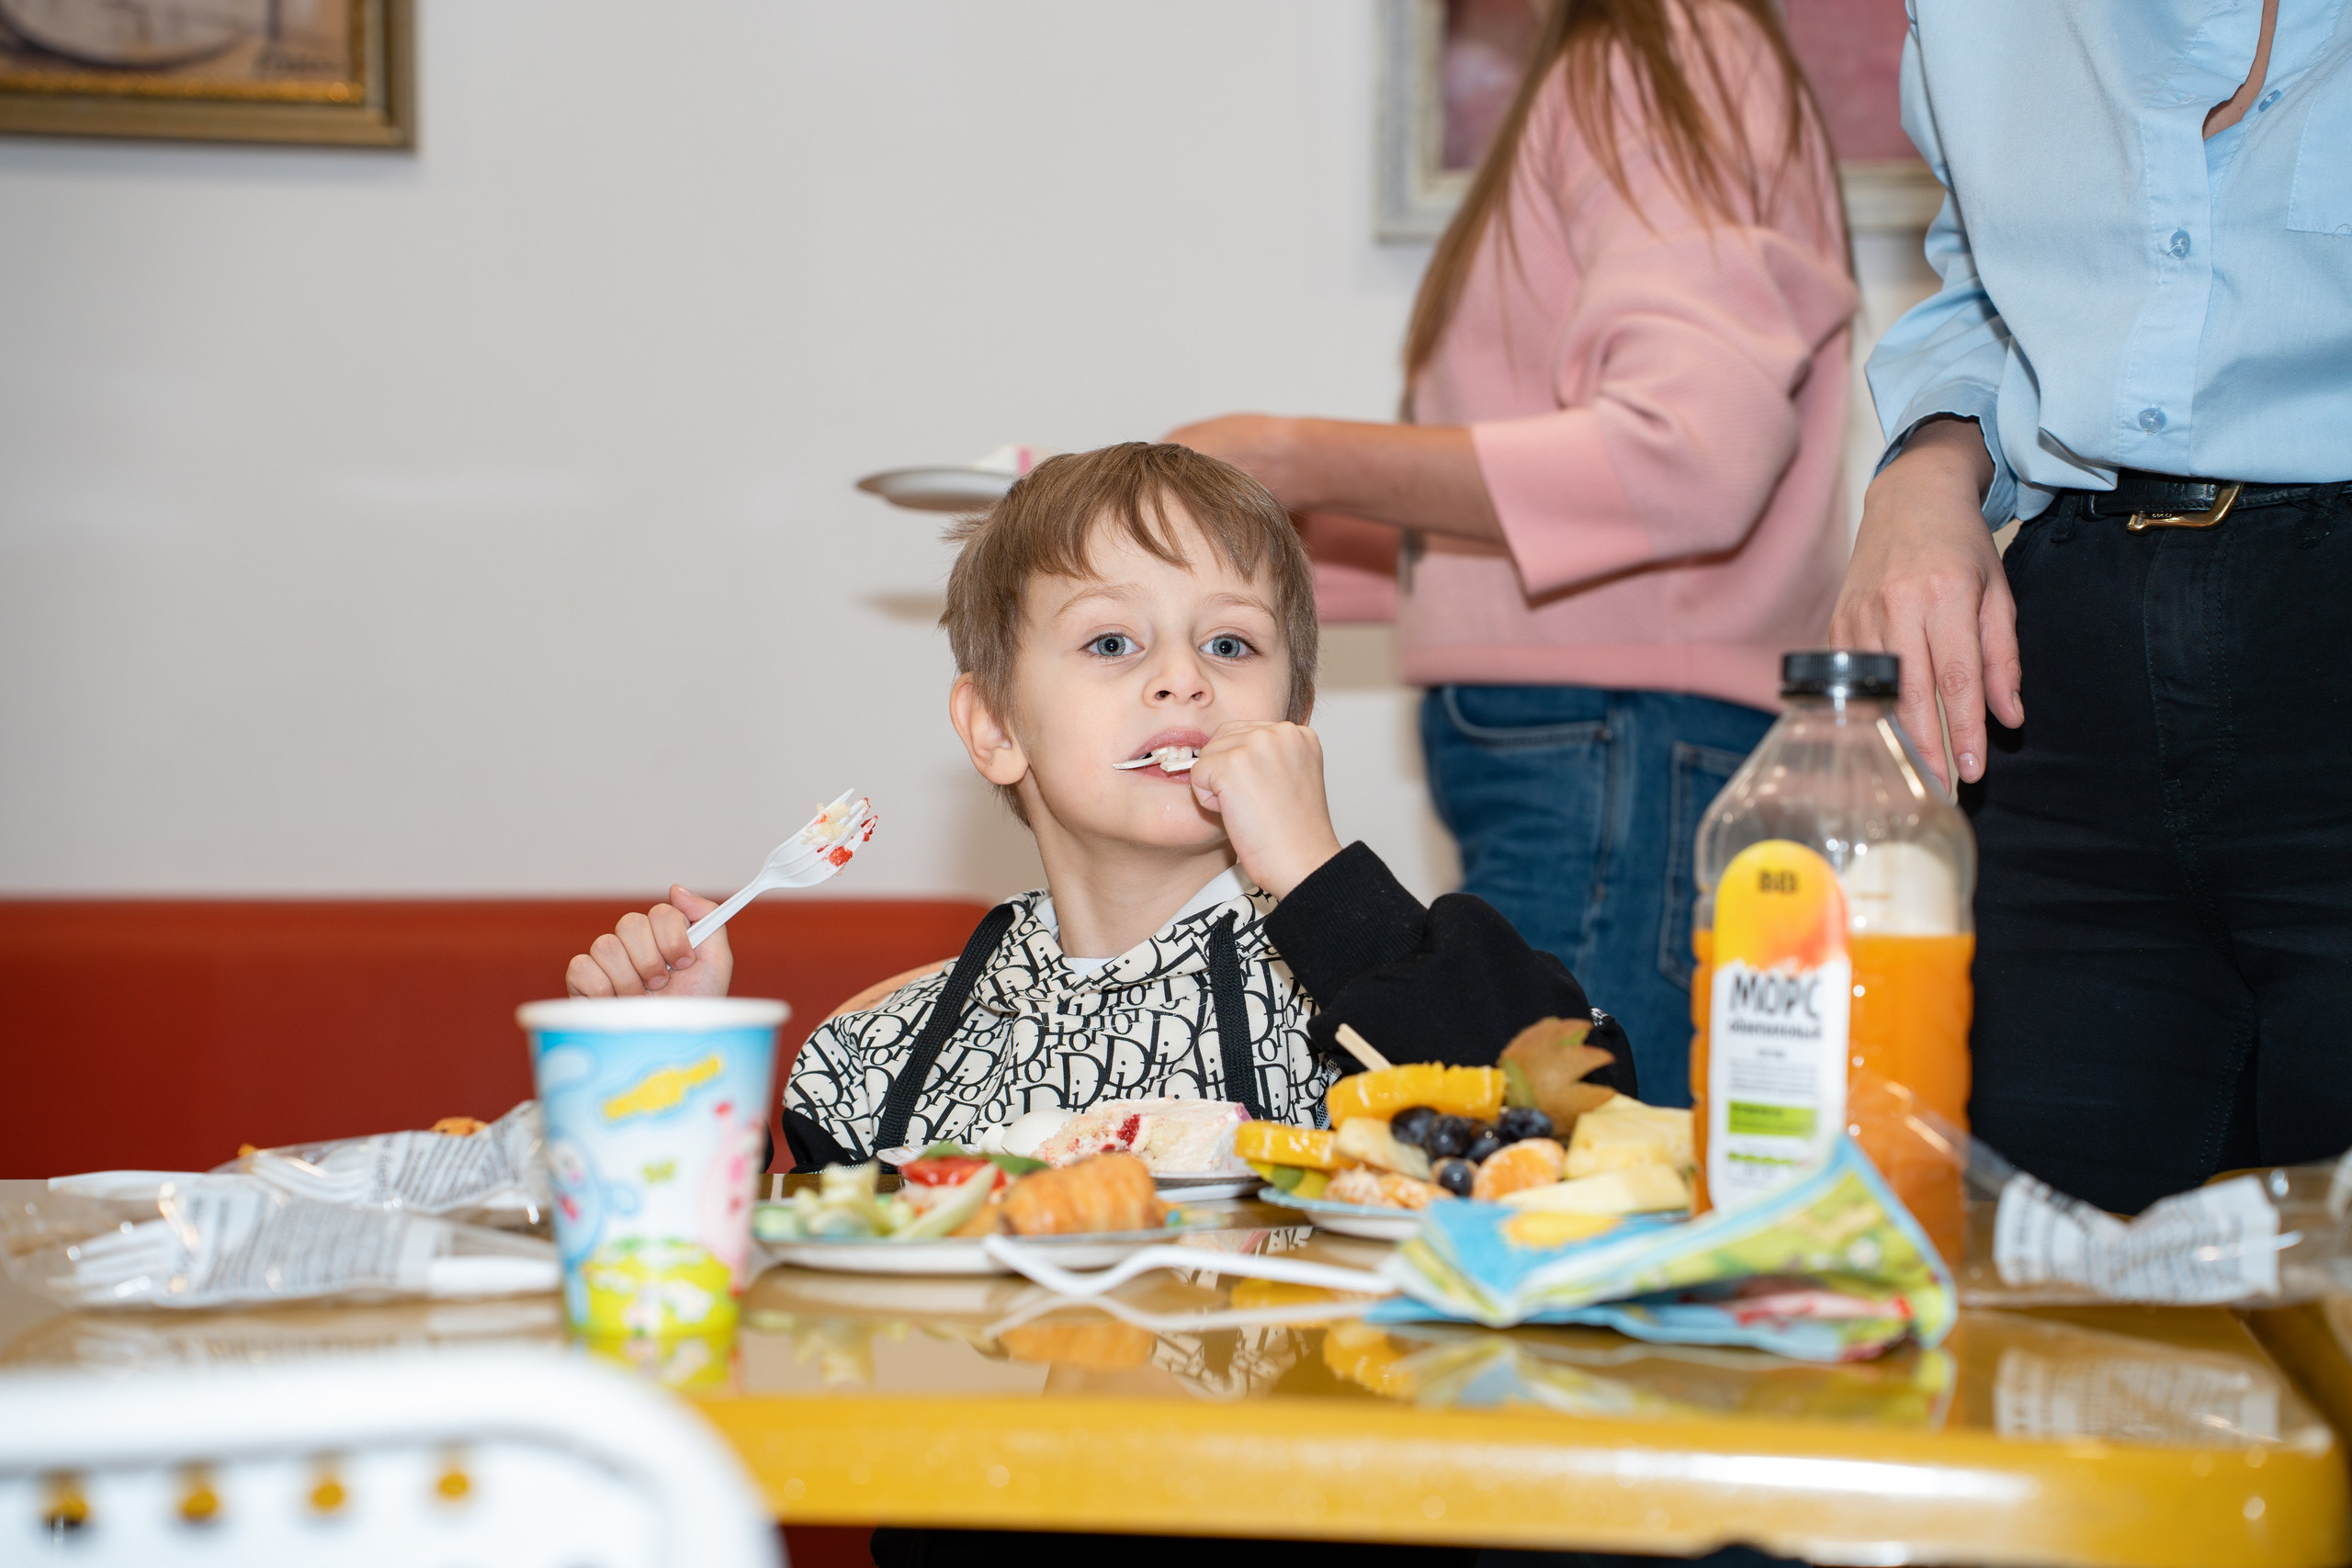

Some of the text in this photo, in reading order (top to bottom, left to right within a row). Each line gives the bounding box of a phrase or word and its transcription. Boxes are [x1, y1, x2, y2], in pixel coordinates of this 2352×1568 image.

[1728, 974, 1822, 1020] МОРС
[944, 1045, 999, 1102] Dior
[1283, 1029, 1326, 1100] Dio
[790, 1070, 859, 1120] Dior
